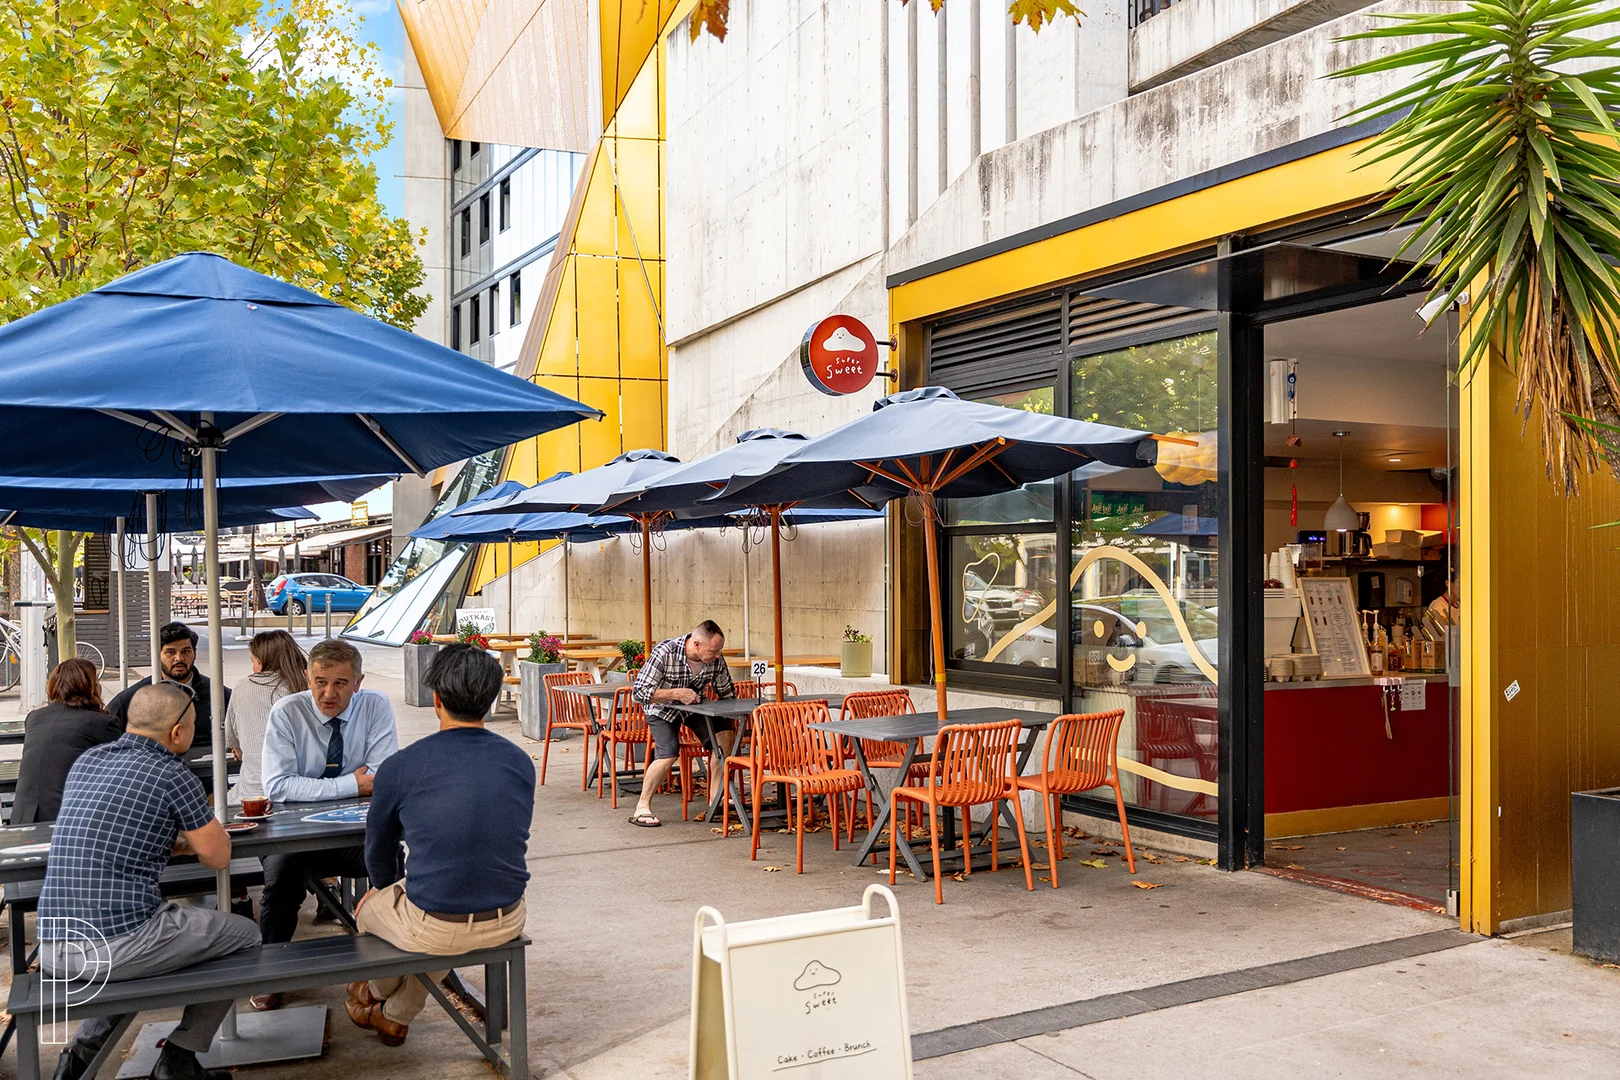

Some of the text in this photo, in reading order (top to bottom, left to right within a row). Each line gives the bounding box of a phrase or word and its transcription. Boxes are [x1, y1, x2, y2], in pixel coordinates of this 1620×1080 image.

[826, 364, 863, 379] Sweet
[458, 614, 495, 624] OUTKAST
[753, 662, 766, 675] 26
[805, 997, 837, 1014] Sweet
[777, 1040, 871, 1065] Cake Coffee Brunch
